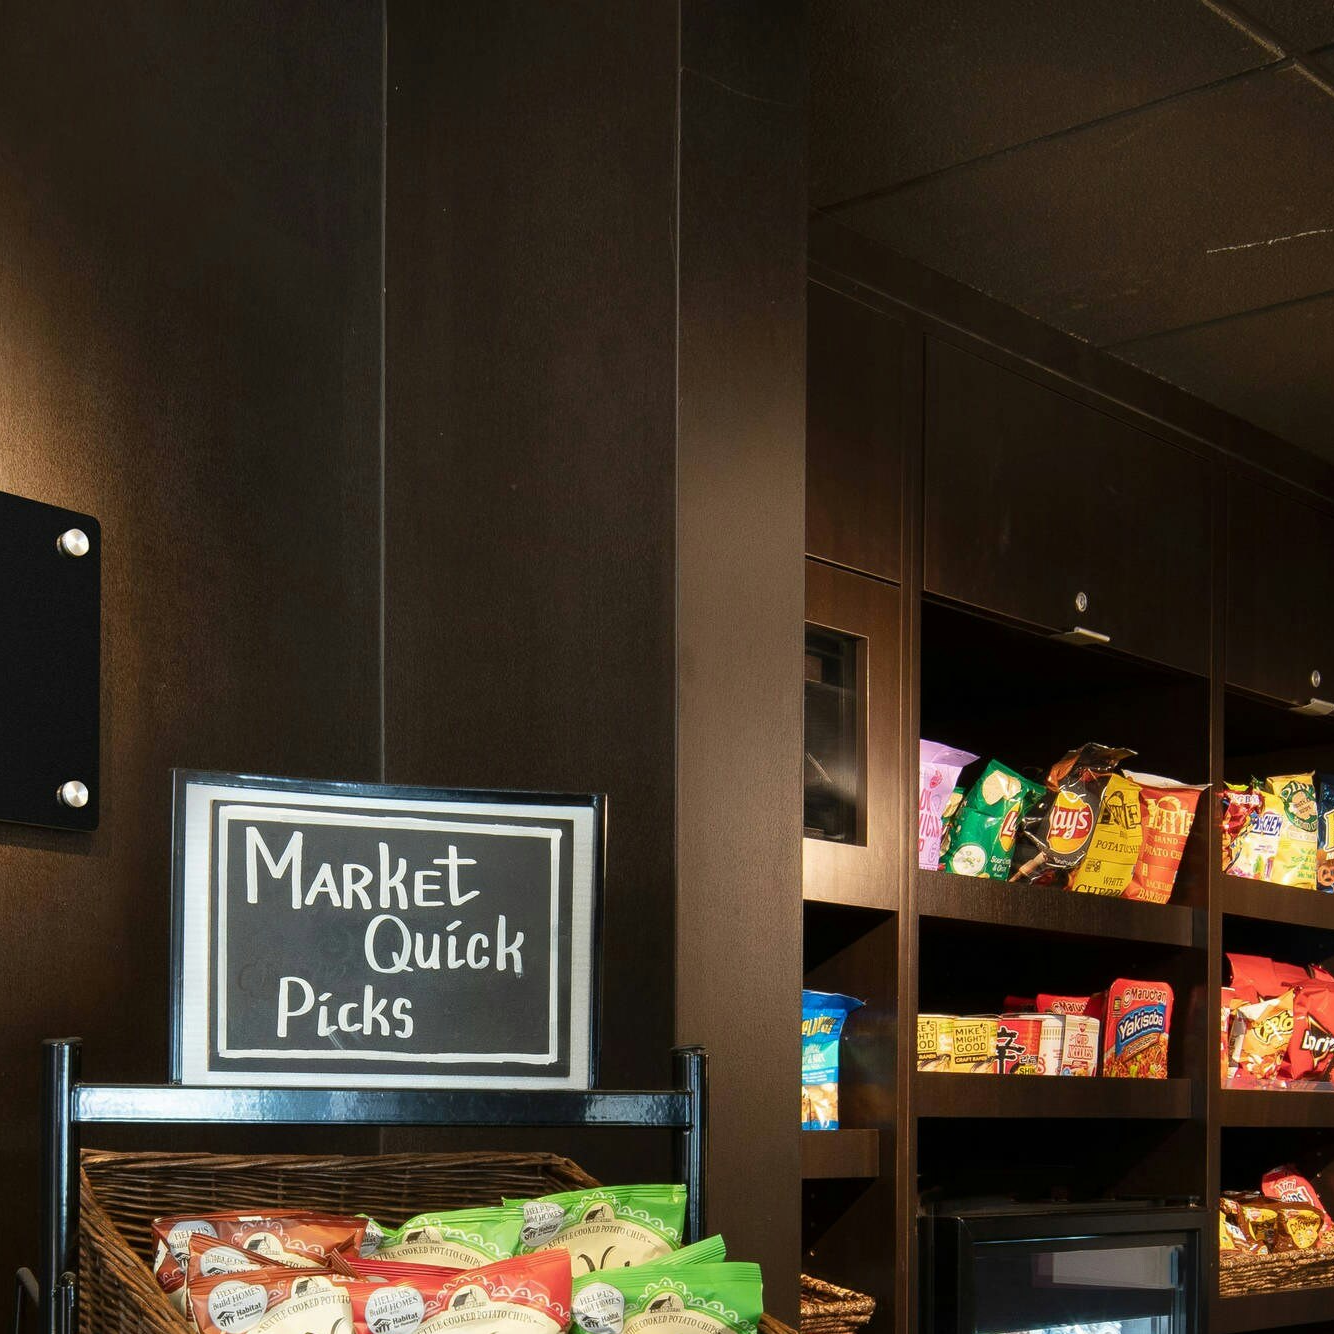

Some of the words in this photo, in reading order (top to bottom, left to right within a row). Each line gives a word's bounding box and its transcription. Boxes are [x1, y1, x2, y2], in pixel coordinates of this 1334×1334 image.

[364, 914, 525, 979] Quick
[1130, 988, 1168, 1002] Maruchan
[276, 976, 414, 1039] Picks
[955, 1025, 987, 1036] MIKE'S
[1119, 1010, 1165, 1040] Yakisoba
[956, 1035, 987, 1045] MIGHTY
[957, 1043, 987, 1053] GOOD
[548, 1230, 574, 1249] KETTLE
[574, 1225, 601, 1237] COOKED
[601, 1225, 627, 1235] POTATO
[398, 1246, 428, 1257] COOKED
[430, 1247, 460, 1258] POTATO
[212, 1299, 231, 1311] Build
[232, 1286, 262, 1303] HOMES
[287, 1298, 319, 1316] COOKED
[320, 1294, 351, 1305] POTATO
[369, 1306, 388, 1318] Build
[389, 1296, 419, 1311] HOMES
[236, 1302, 262, 1317] Habitat
[392, 1312, 419, 1325] Habitat
[443, 1312, 477, 1328] COOKED
[639, 1315, 668, 1327] COOKED
[668, 1315, 697, 1327] POTATO
[697, 1319, 721, 1334] CHIPS
